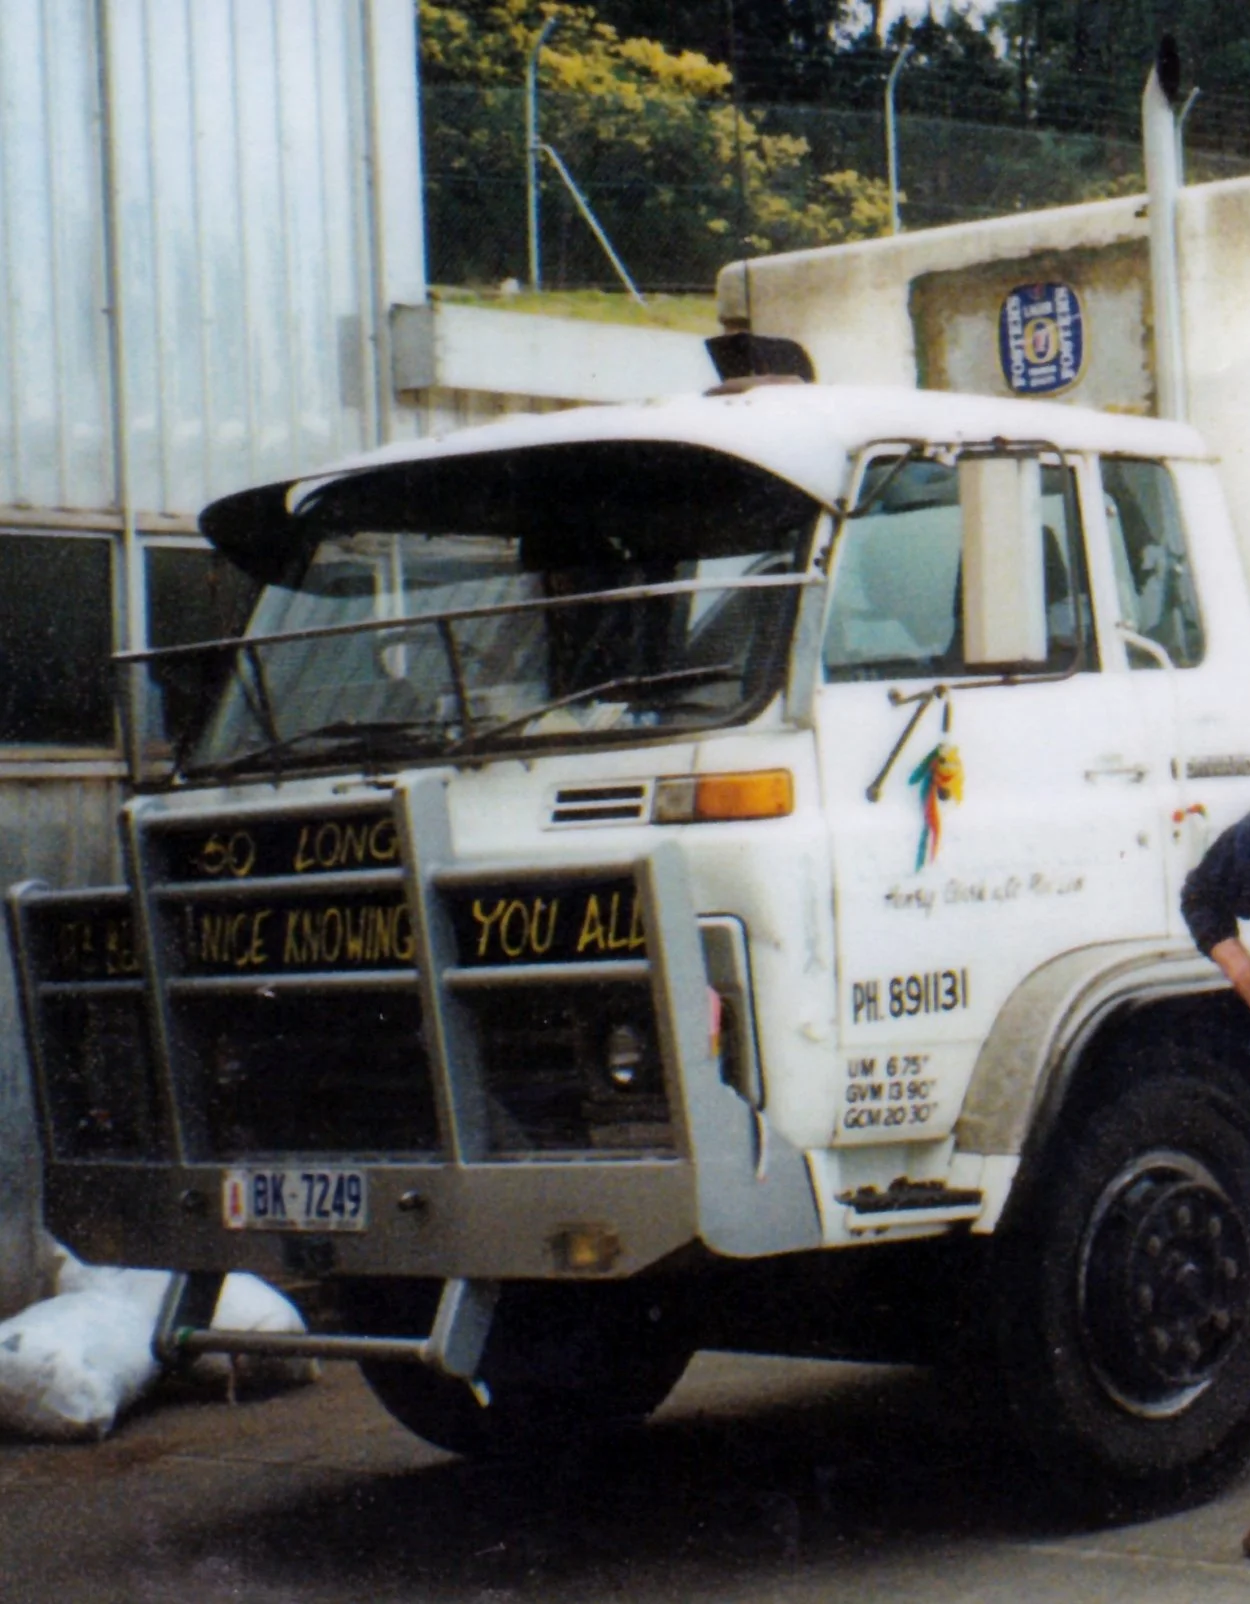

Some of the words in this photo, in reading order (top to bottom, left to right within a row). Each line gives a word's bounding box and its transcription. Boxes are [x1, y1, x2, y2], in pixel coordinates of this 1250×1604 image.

[202, 831, 256, 877] SO
[293, 818, 401, 872] LONG
[200, 908, 273, 966] NICE
[282, 904, 417, 964] KNOWING
[472, 895, 560, 958] YOU
[576, 891, 648, 953] ALL
[889, 967, 968, 1018] 891131
[843, 1106, 882, 1129] GCM
[846, 1081, 884, 1104] GVM
